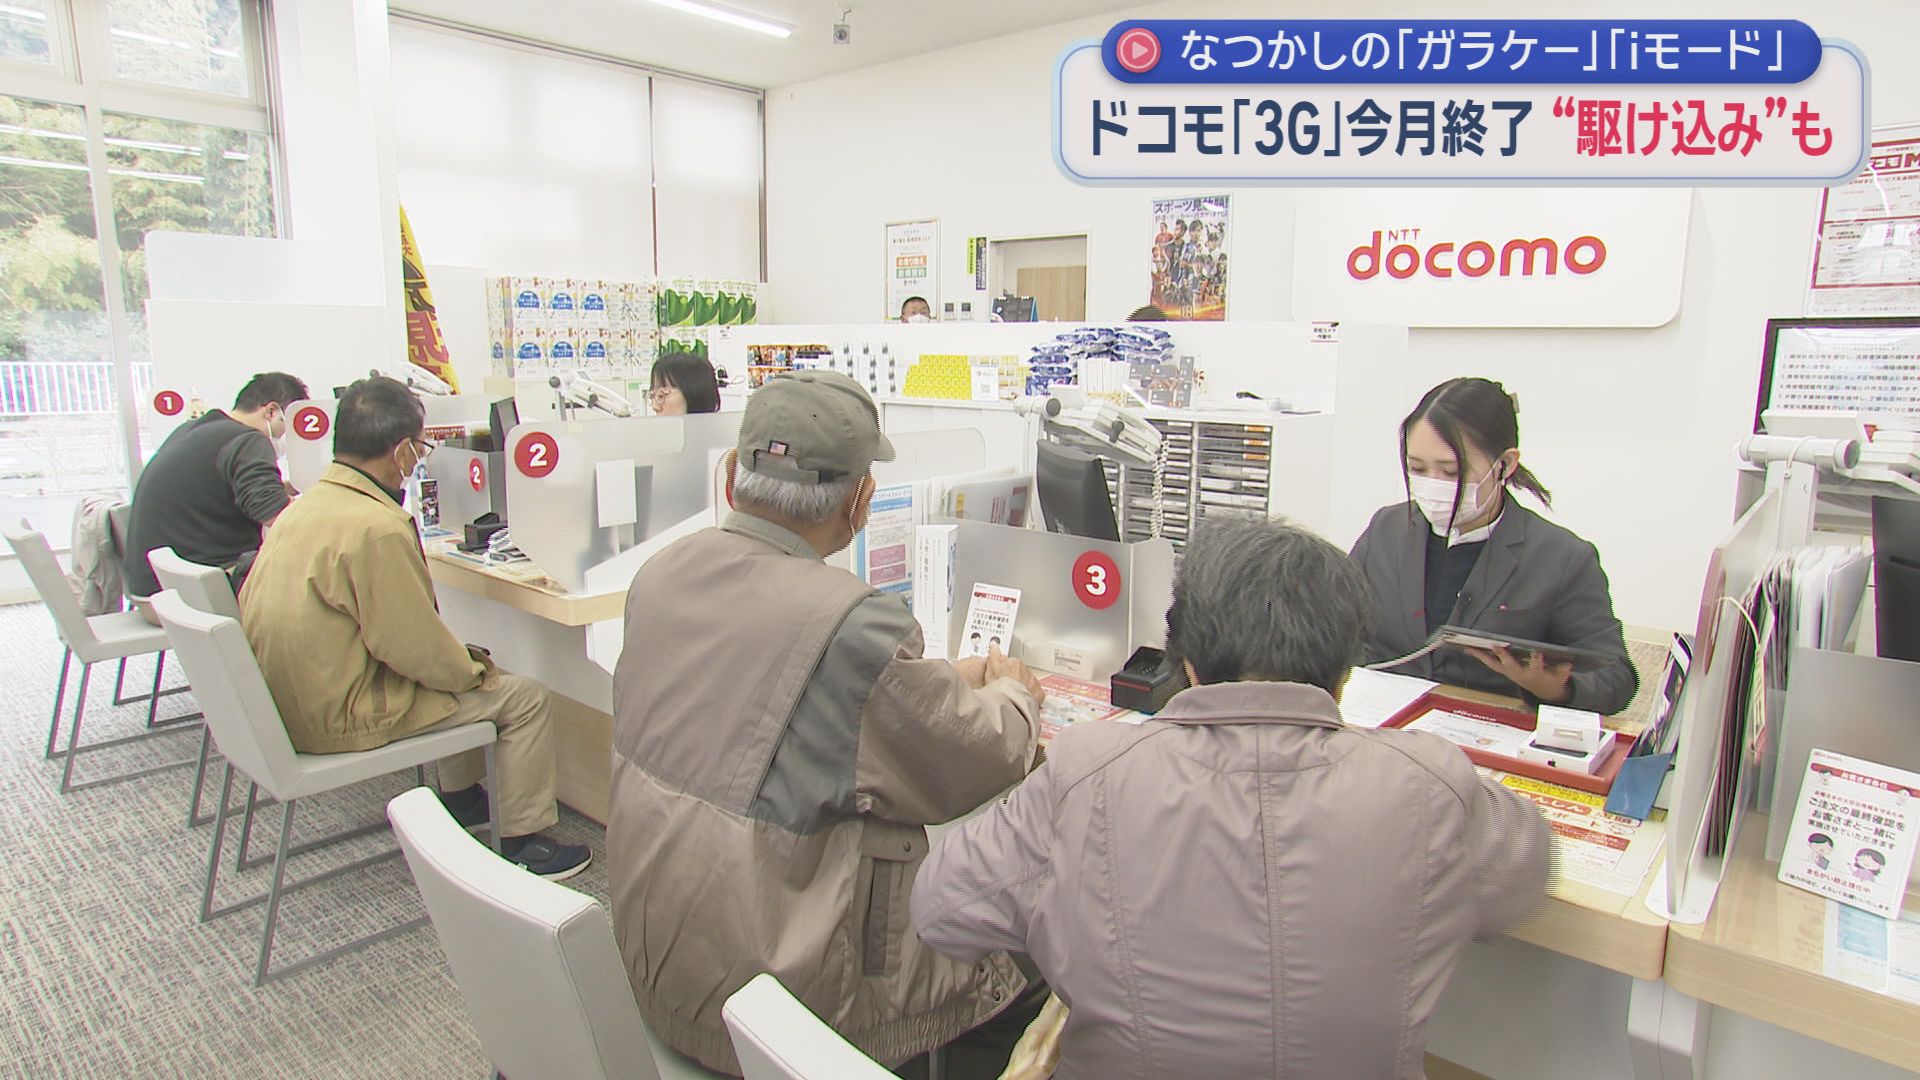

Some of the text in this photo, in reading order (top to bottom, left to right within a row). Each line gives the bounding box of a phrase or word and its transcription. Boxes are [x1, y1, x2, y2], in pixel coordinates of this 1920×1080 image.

[1388, 229, 1421, 241] NTT
[1346, 230, 1607, 280] docomo
[162, 396, 174, 411] 1
[304, 414, 320, 432] 2
[529, 443, 548, 468] 2
[472, 466, 481, 484] 2
[1085, 564, 1107, 596] 3
[1811, 808, 1897, 841] お客さまと一緒に
